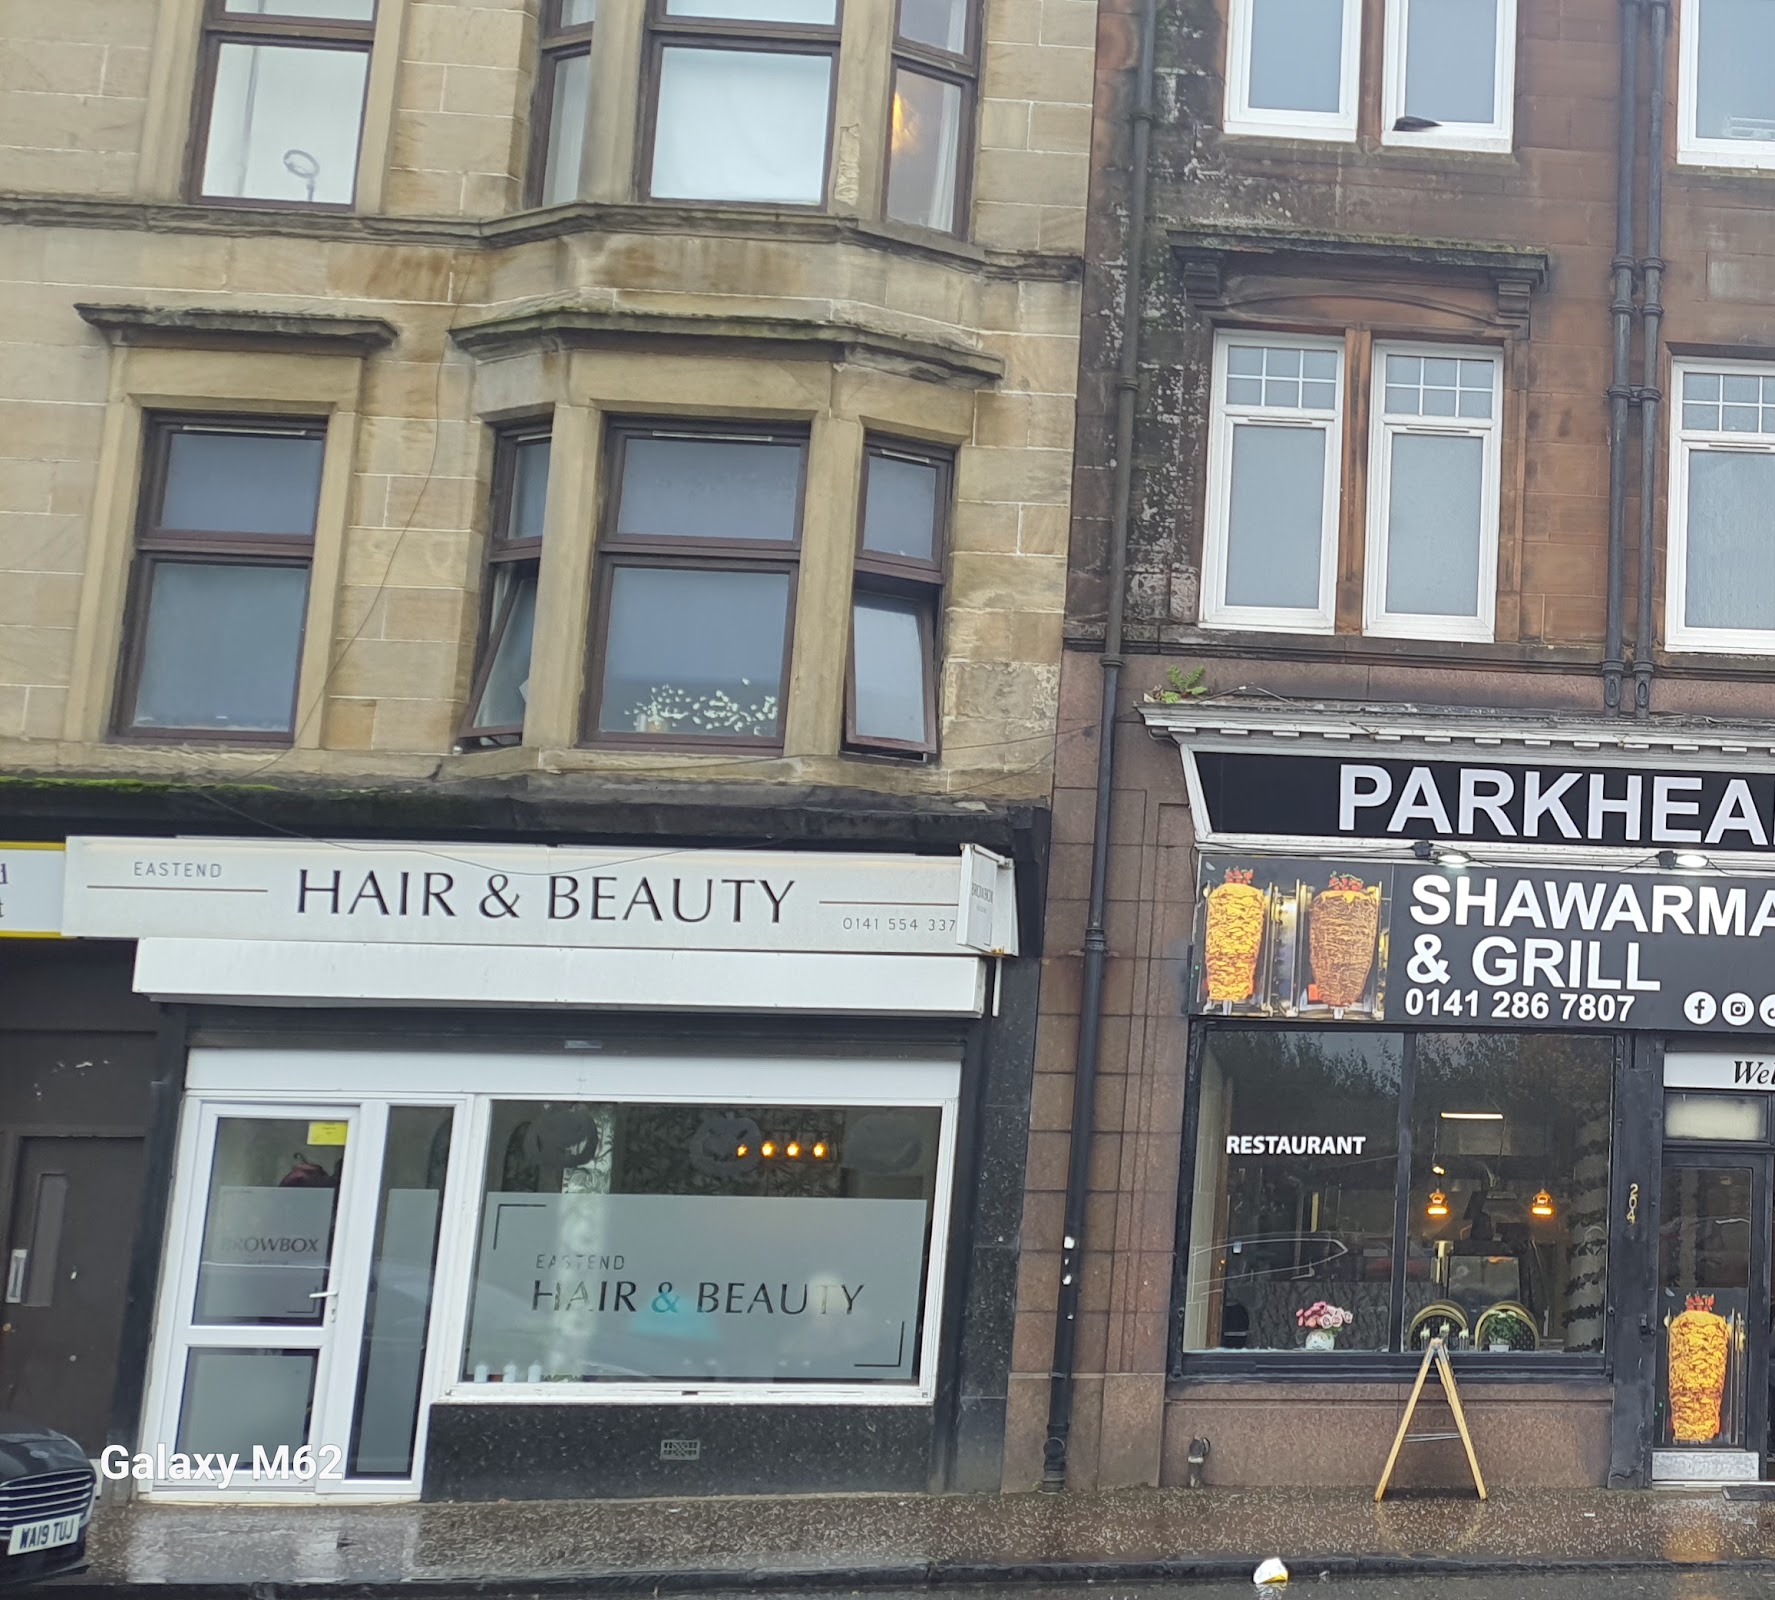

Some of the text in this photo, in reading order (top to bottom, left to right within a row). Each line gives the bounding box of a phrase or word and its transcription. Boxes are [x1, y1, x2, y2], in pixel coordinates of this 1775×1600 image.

[133, 861, 223, 879] EASTEND
[297, 868, 795, 923] HAIR & BEAUTY
[842, 917, 956, 932] 0141 554 337
[1405, 933, 1661, 992] & GRILL
[1404, 987, 1636, 1022] 0141 286 7807
[1225, 1135, 1366, 1156] RESTAURANT
[1626, 1182, 1639, 1225] 204
[535, 1253, 625, 1271] EASTEND
[531, 1279, 865, 1316] HAIR & BEAUTY
[19, 1517, 75, 1550] WA19 TUJ
